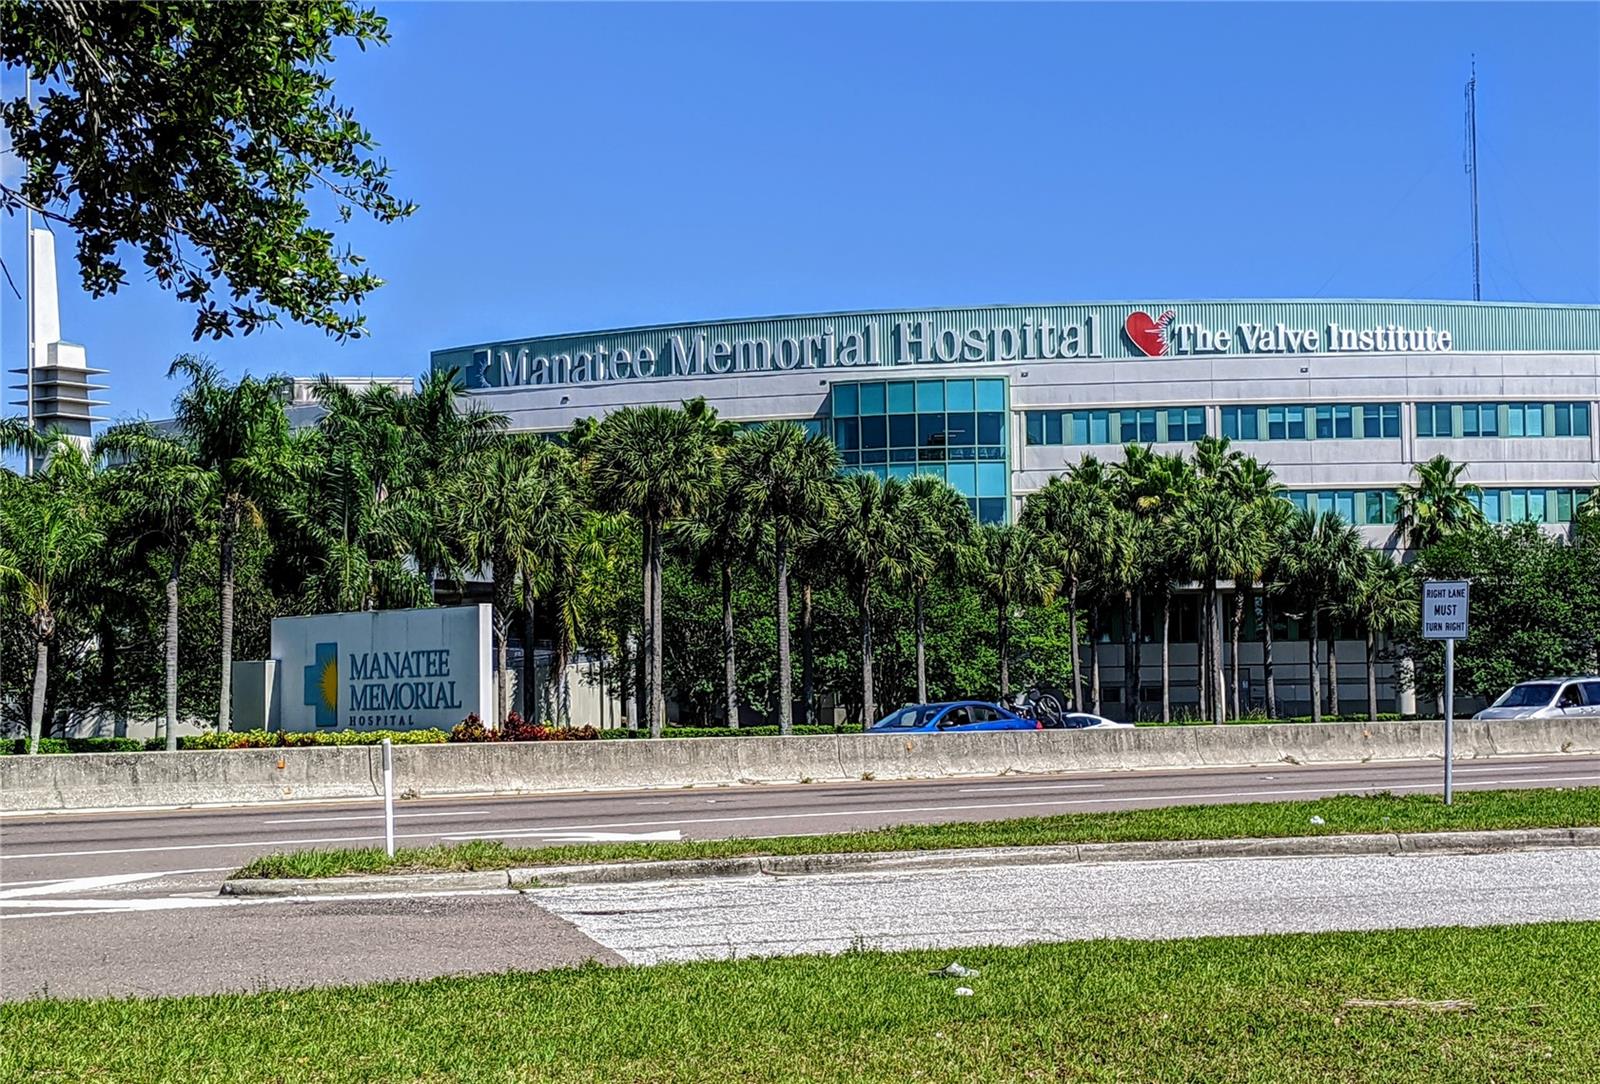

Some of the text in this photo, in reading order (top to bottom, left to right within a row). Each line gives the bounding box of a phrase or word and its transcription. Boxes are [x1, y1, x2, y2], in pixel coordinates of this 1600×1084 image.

[1175, 322, 1453, 351] The Valve Institute
[498, 314, 1102, 387] Manatee Memorial Hospital
[1426, 588, 1466, 599] RIGHT LANE
[1433, 604, 1457, 616] MUST
[1425, 622, 1465, 632] TURN RIGHT
[349, 649, 450, 680] MANATEE
[349, 681, 462, 711] MEMORIAL
[350, 715, 415, 726] HOSPITAL
